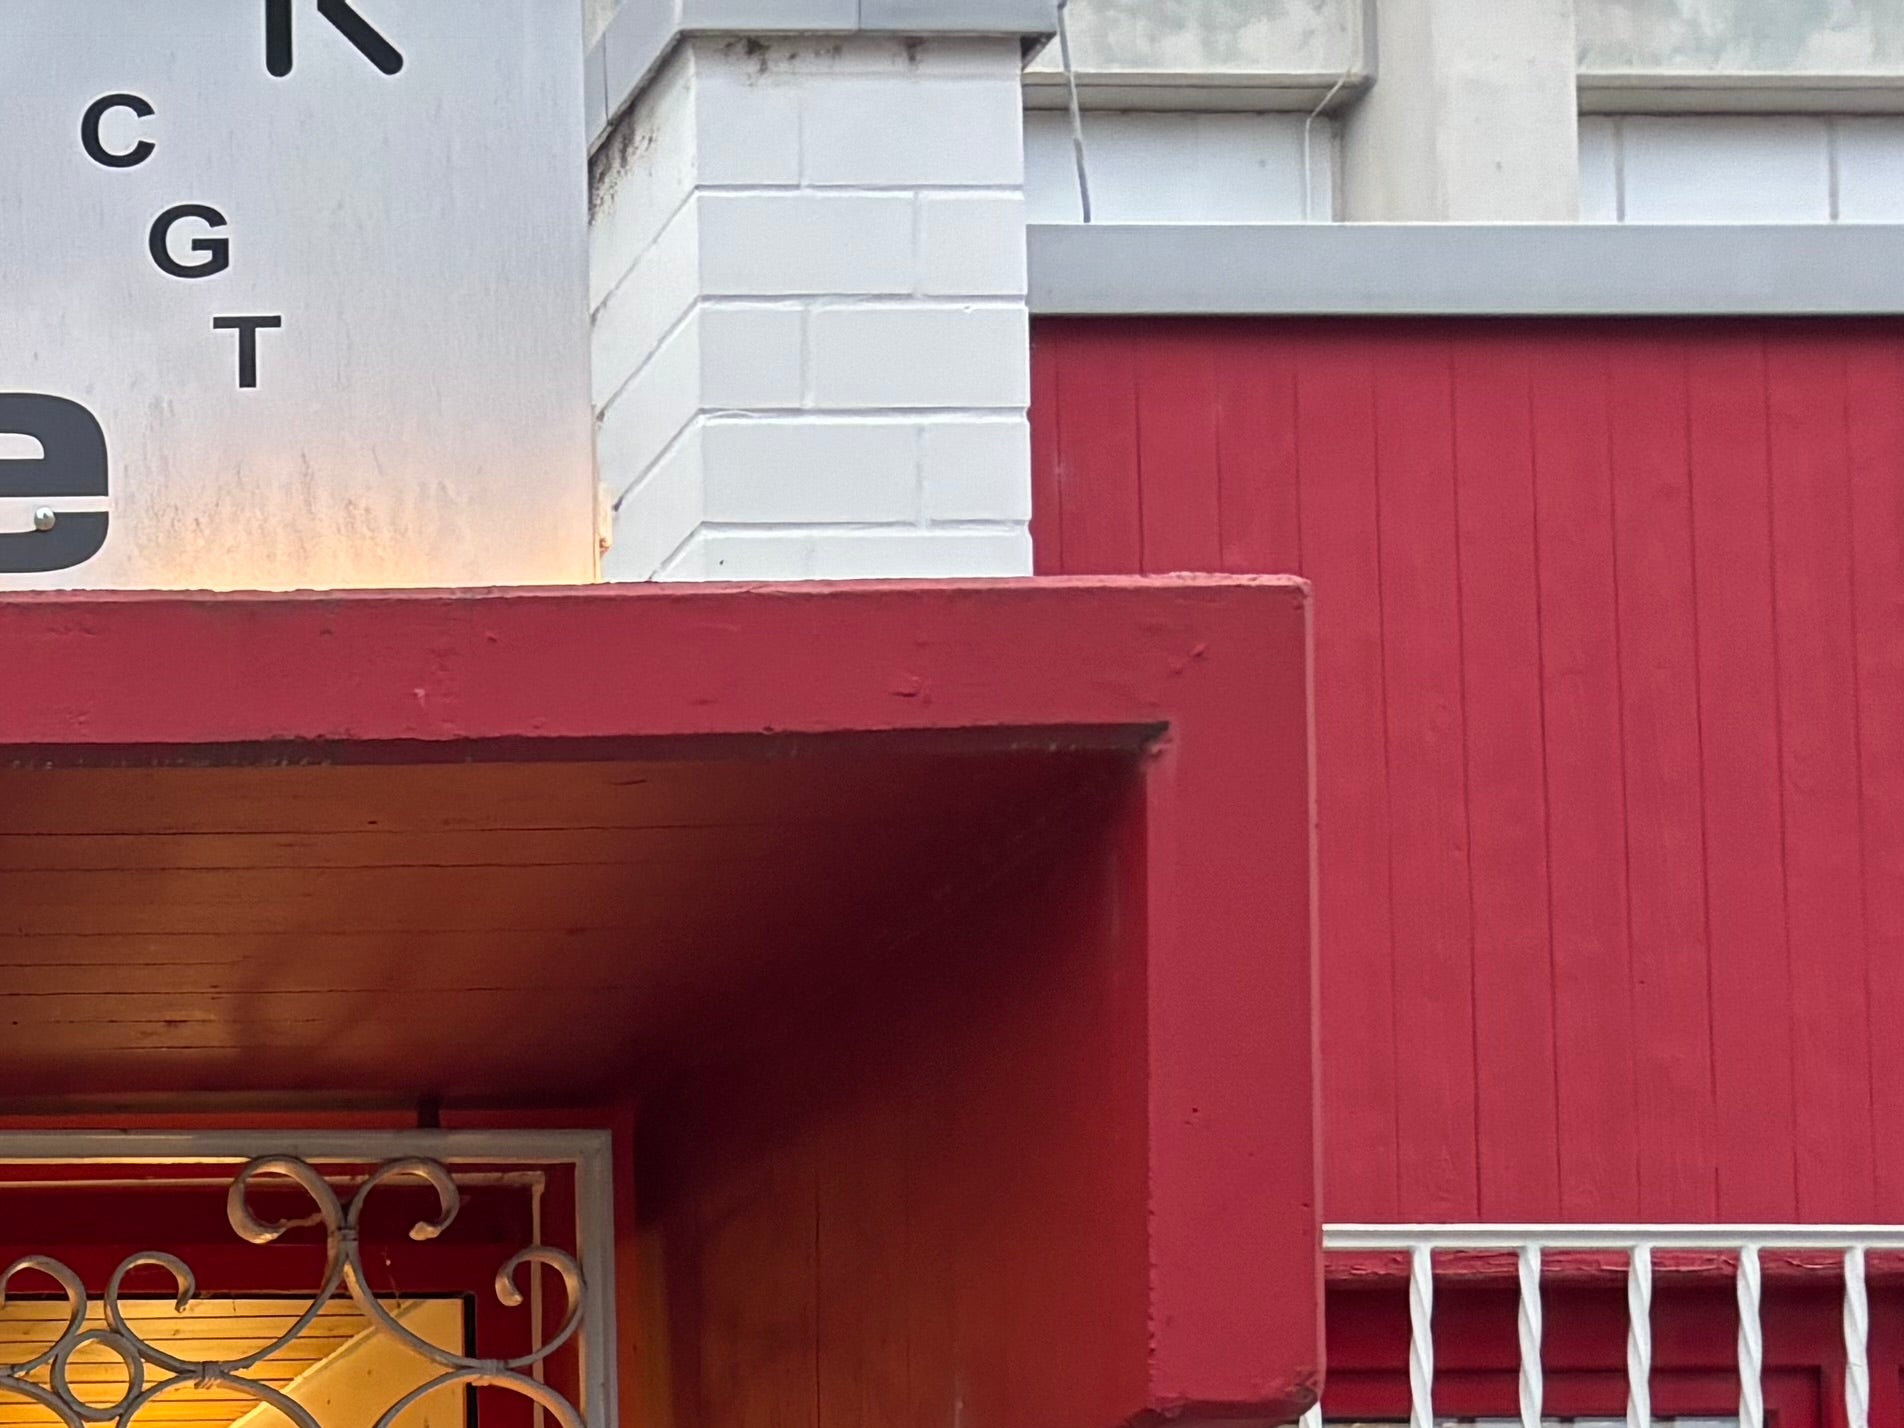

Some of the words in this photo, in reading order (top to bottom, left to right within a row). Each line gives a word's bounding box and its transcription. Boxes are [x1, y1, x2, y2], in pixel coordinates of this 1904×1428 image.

[80, 93, 156, 168] C
[148, 203, 230, 279] G
[212, 315, 282, 388] T
